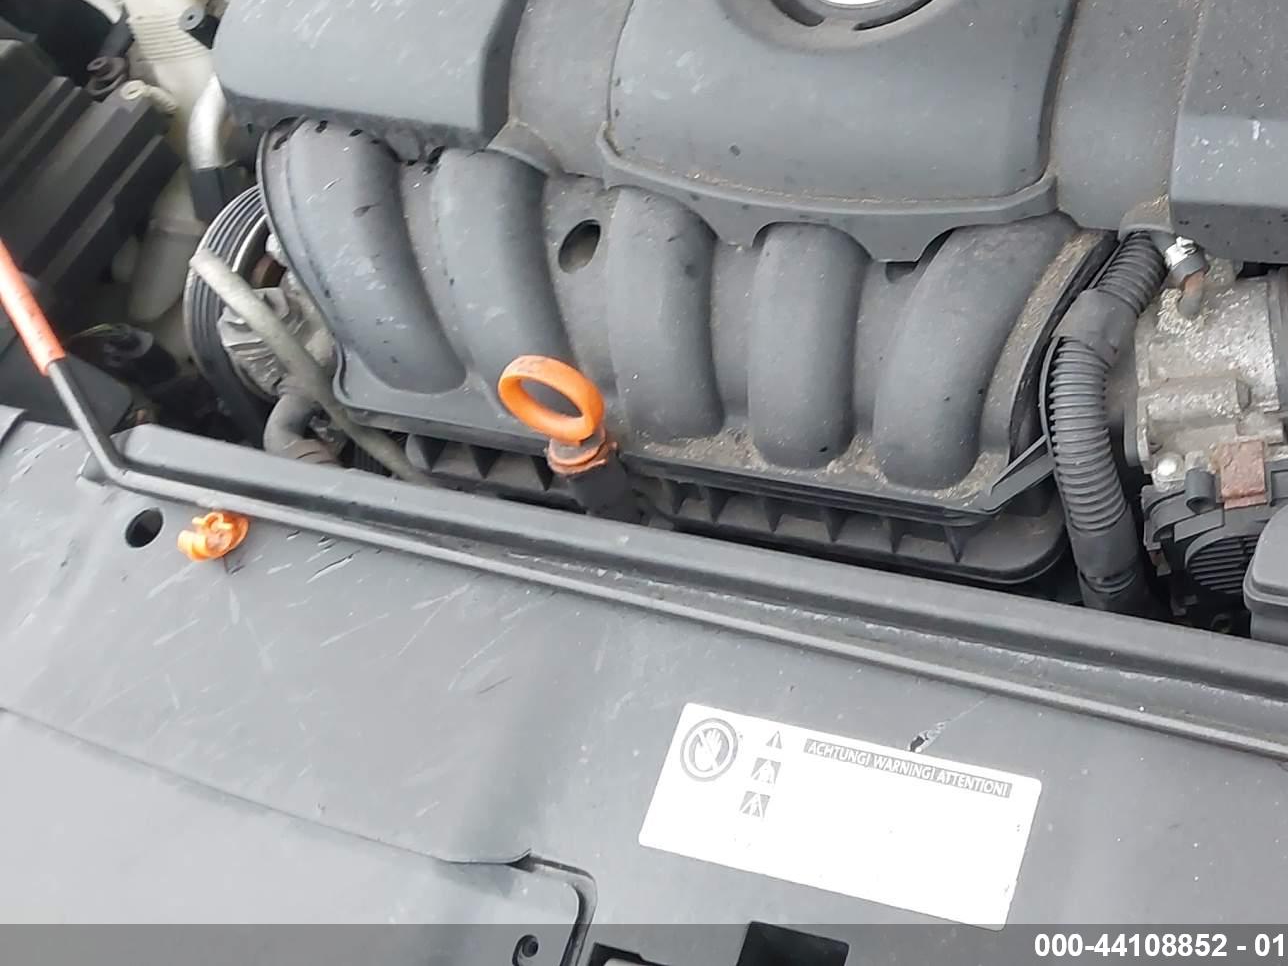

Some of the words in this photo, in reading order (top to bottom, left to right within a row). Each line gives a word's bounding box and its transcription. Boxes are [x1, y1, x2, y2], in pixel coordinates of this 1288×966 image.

[807, 741, 871, 766] ACHTUNG!
[873, 754, 937, 782] WARNING!
[936, 768, 1010, 798] ATTENTION!
